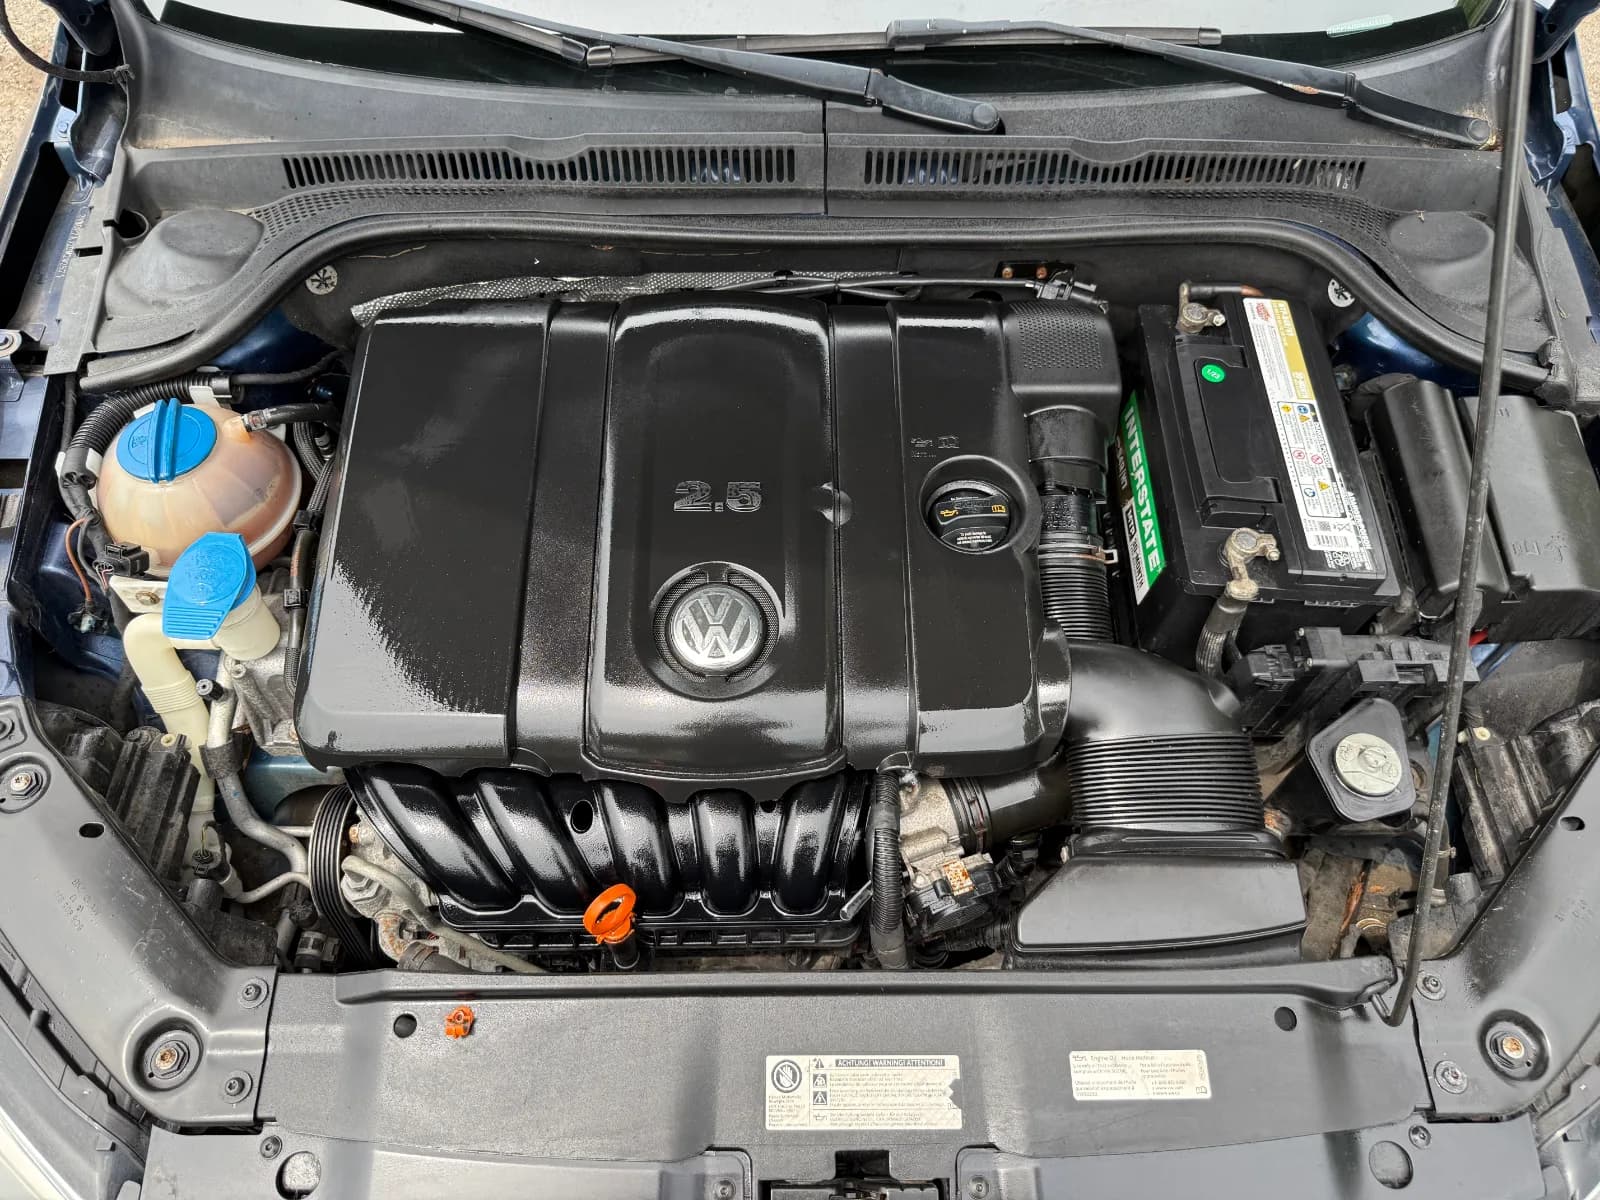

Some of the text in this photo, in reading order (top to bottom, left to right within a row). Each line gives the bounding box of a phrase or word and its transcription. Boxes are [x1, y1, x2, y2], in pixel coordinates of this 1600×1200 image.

[673, 480, 763, 513] 2.5
[1123, 406, 1159, 572] INTERSTATE
[838, 1059, 943, 1067] ACHTUNG! WARNING! ATTENTION!
